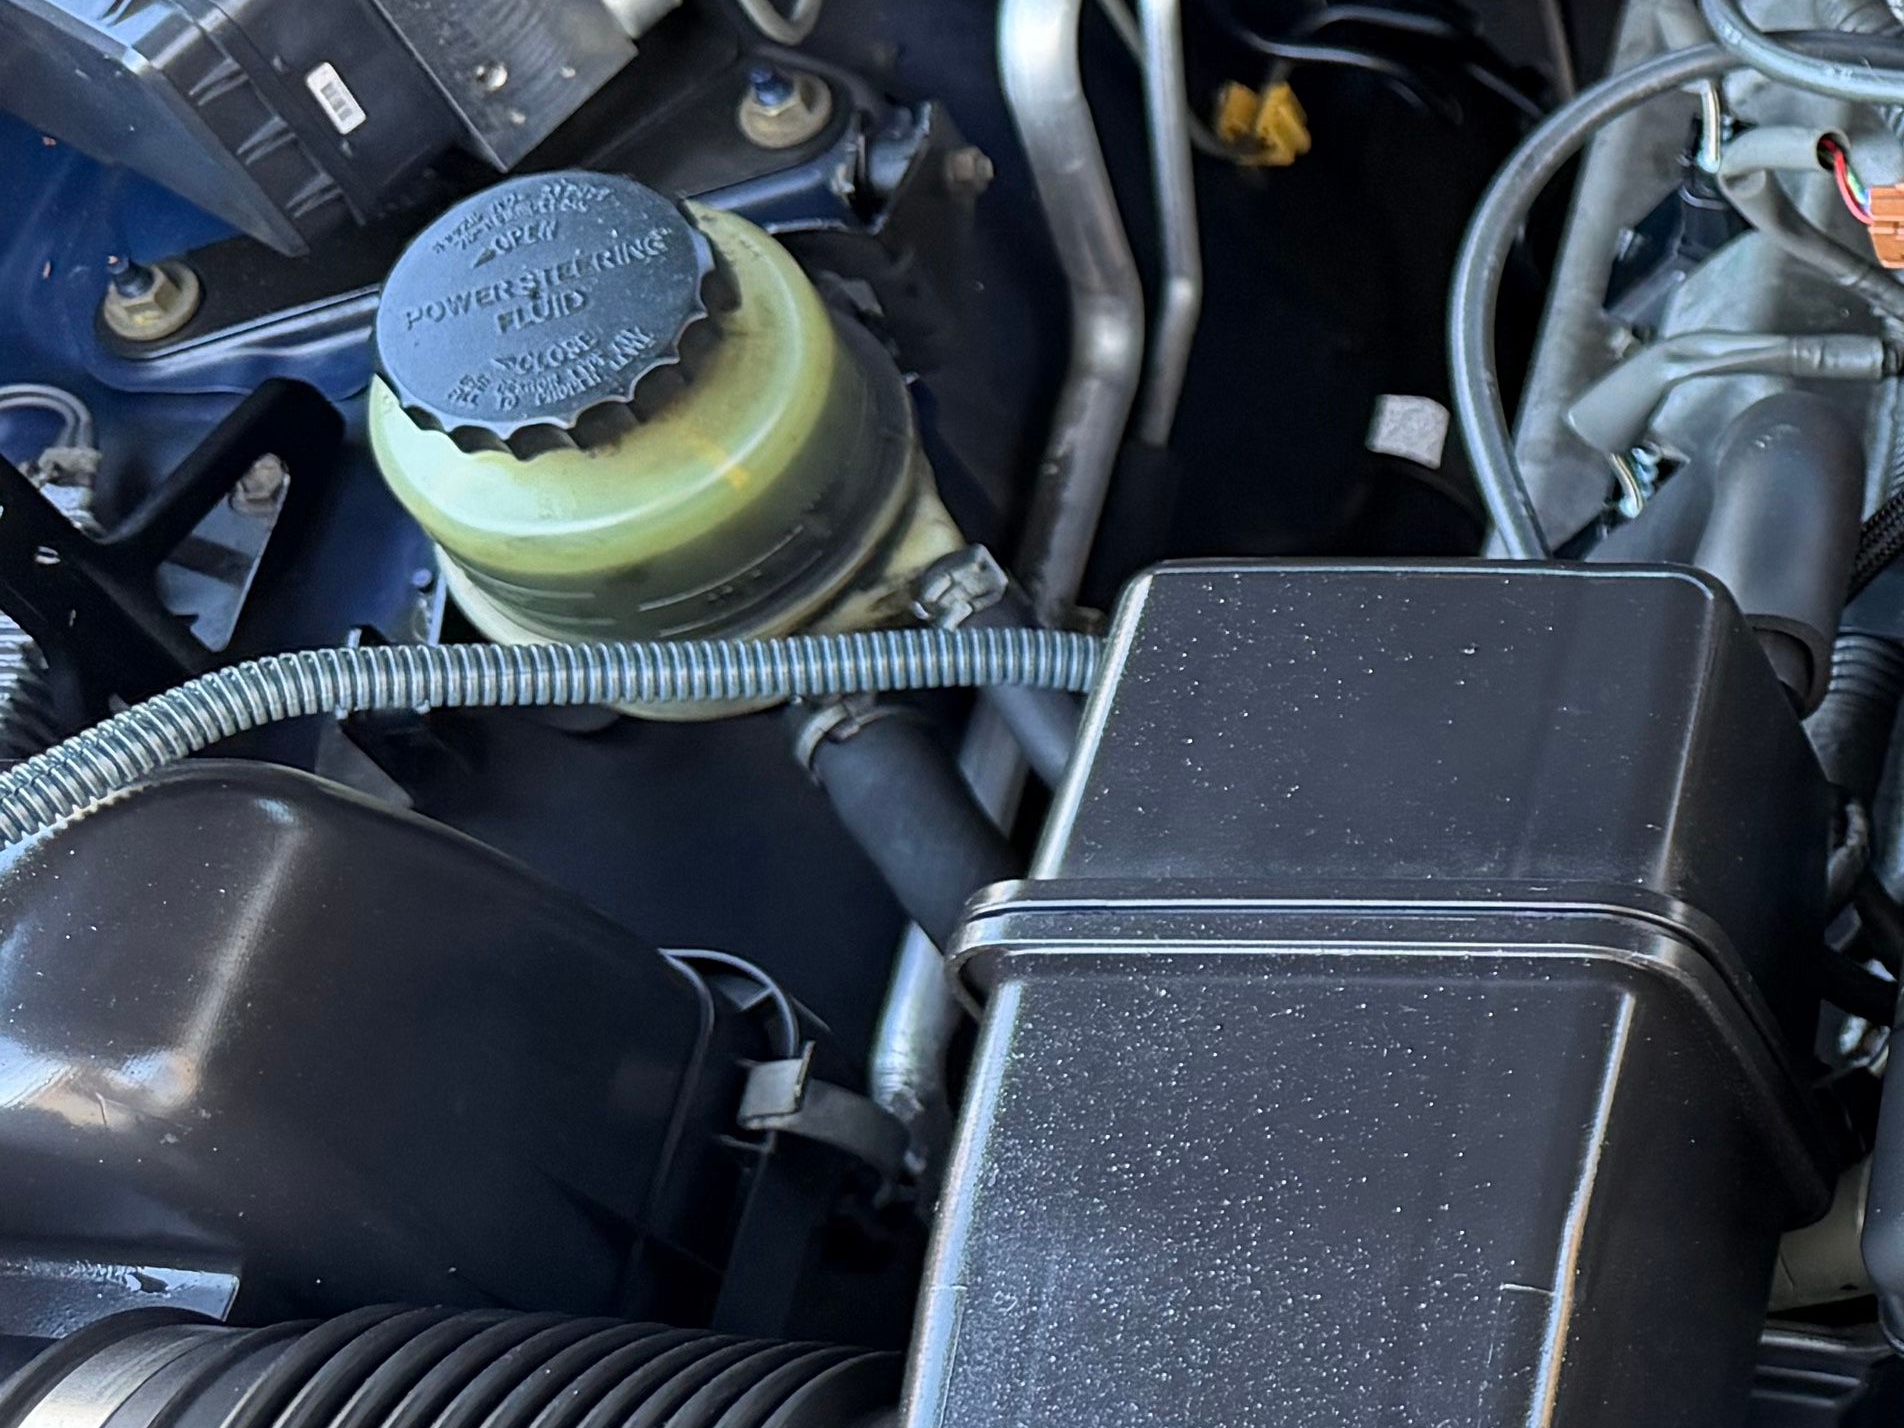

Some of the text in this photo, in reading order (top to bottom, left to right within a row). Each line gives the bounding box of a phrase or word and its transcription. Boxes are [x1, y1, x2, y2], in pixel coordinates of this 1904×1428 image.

[495, 221, 559, 255] OPEN
[404, 228, 670, 330] POWER STEERING
[497, 287, 587, 334] FLUID
